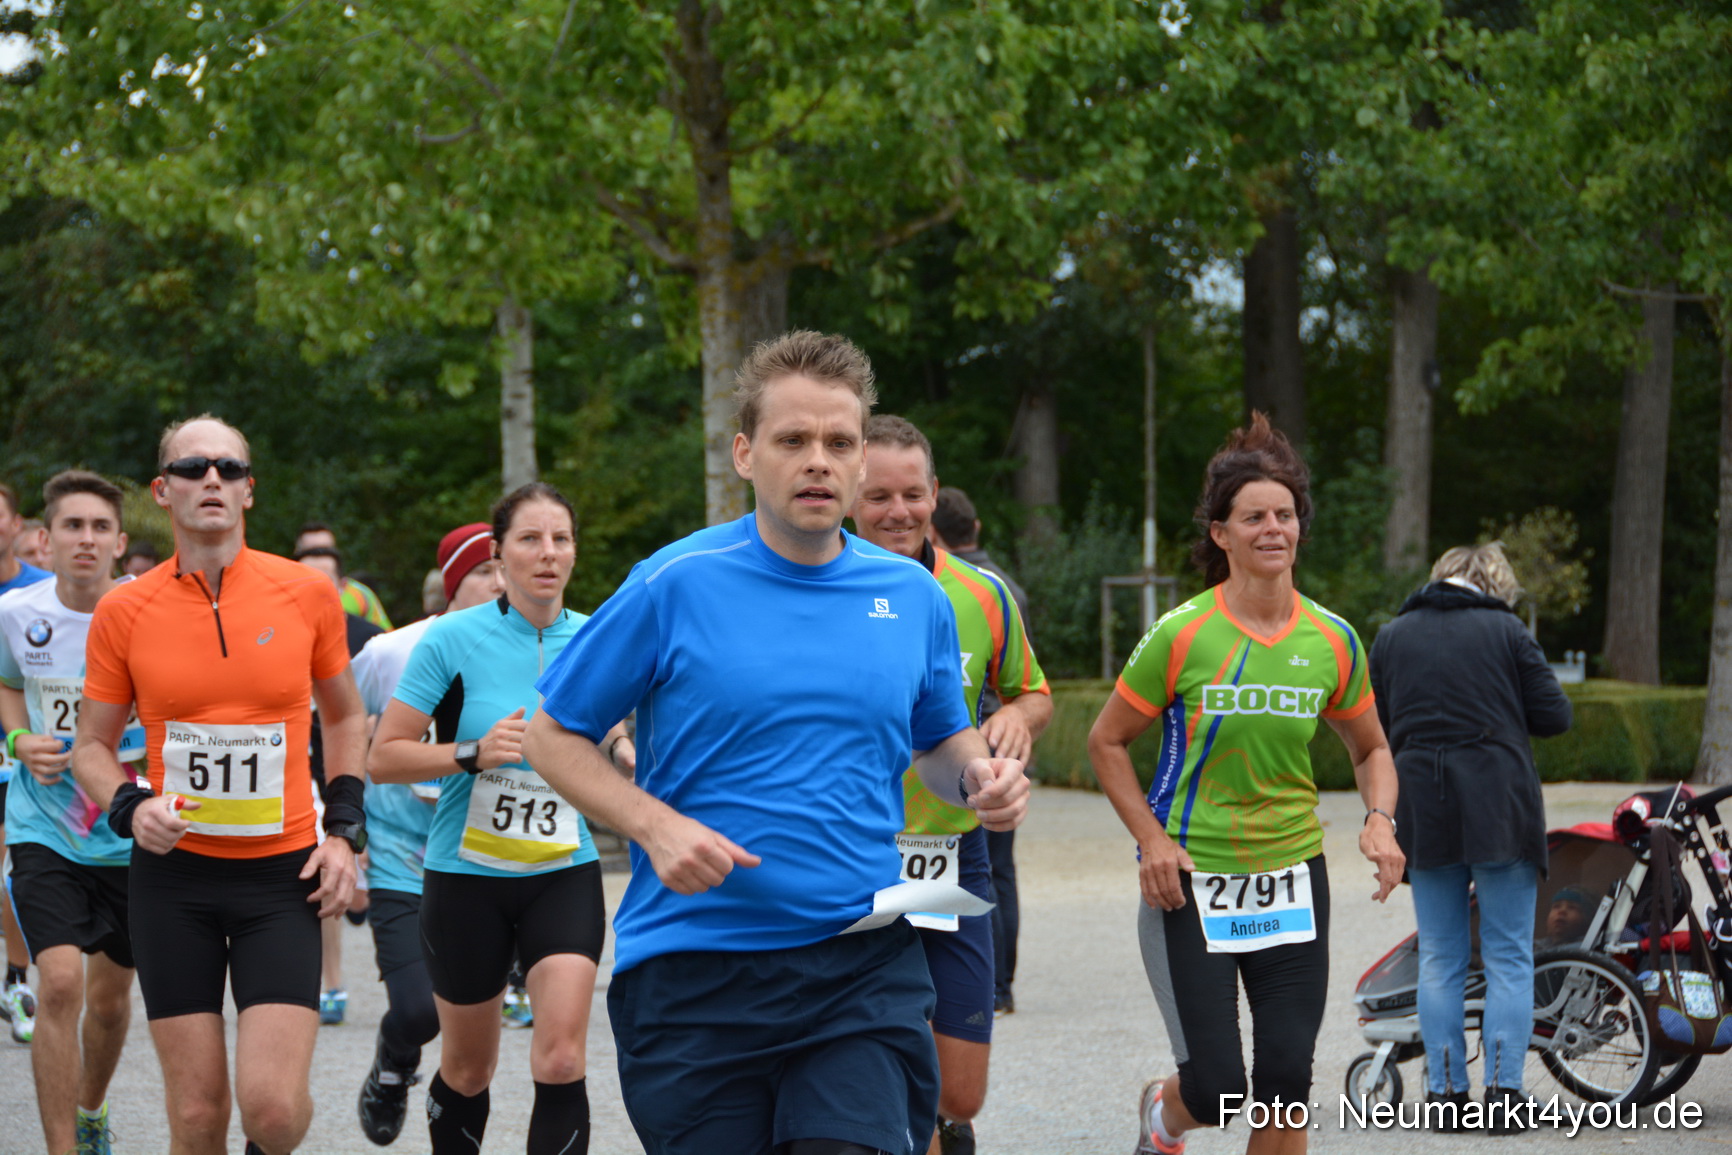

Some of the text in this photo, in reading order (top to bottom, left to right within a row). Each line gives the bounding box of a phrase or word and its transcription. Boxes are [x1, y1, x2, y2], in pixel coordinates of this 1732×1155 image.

[25, 652, 53, 660] PARTL
[42, 685, 72, 694] PARTL
[1202, 684, 1324, 718] BOCK
[169, 732, 266, 747] PARTL Neumarkt
[189, 752, 258, 793] 511
[479, 774, 556, 794] PARTL Neumar
[492, 794, 557, 836] 513
[900, 853, 947, 880] 92
[1206, 870, 1296, 910] 2791
[1231, 919, 1280, 936] Andrea
